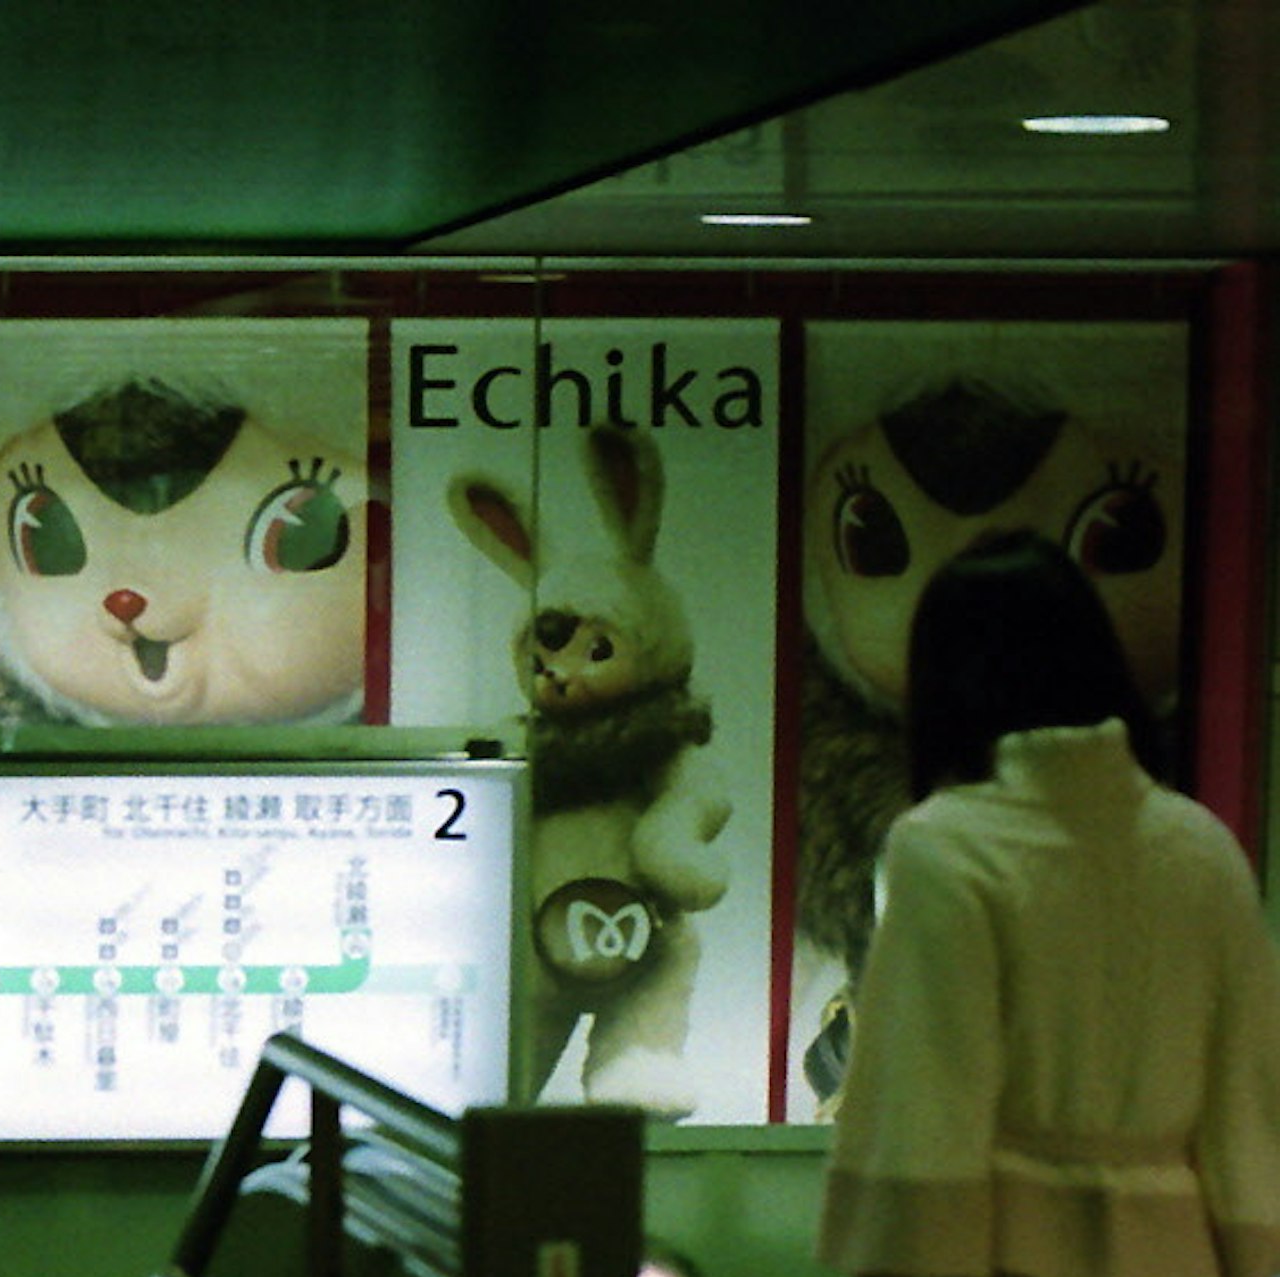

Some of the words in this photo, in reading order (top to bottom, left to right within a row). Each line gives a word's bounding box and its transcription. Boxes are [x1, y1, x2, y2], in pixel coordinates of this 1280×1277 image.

[408, 342, 764, 430] Echika
[21, 794, 109, 823] 大手町
[123, 794, 208, 822] 北千住
[295, 794, 413, 823] 取手方面
[433, 787, 468, 842] 2
